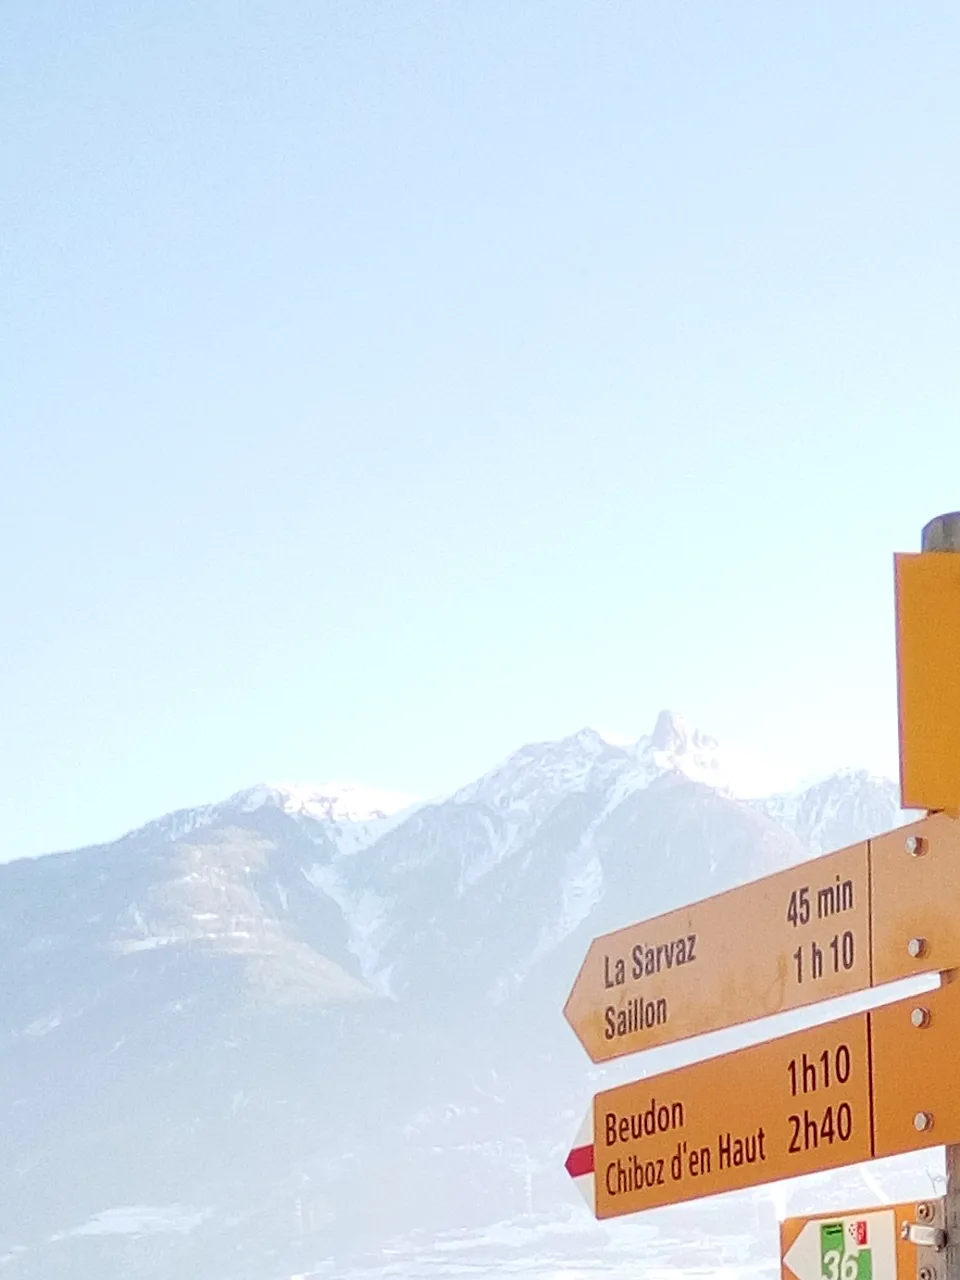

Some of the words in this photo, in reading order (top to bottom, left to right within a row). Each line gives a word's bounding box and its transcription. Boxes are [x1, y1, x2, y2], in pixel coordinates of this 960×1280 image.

[787, 886, 811, 927] 45
[817, 875, 853, 917] min
[604, 955, 625, 989] La
[632, 934, 697, 979] Sarvaz
[793, 946, 804, 984] 1
[812, 943, 823, 979] h
[830, 931, 854, 972] 10
[604, 996, 668, 1041] Saillon
[788, 1045, 852, 1097] 1h10
[605, 1101, 684, 1147] Beudon
[788, 1102, 853, 1154] 2h40
[606, 1154, 665, 1197] Chiboz
[670, 1144, 711, 1179] d'en
[718, 1127, 766, 1170] Haut
